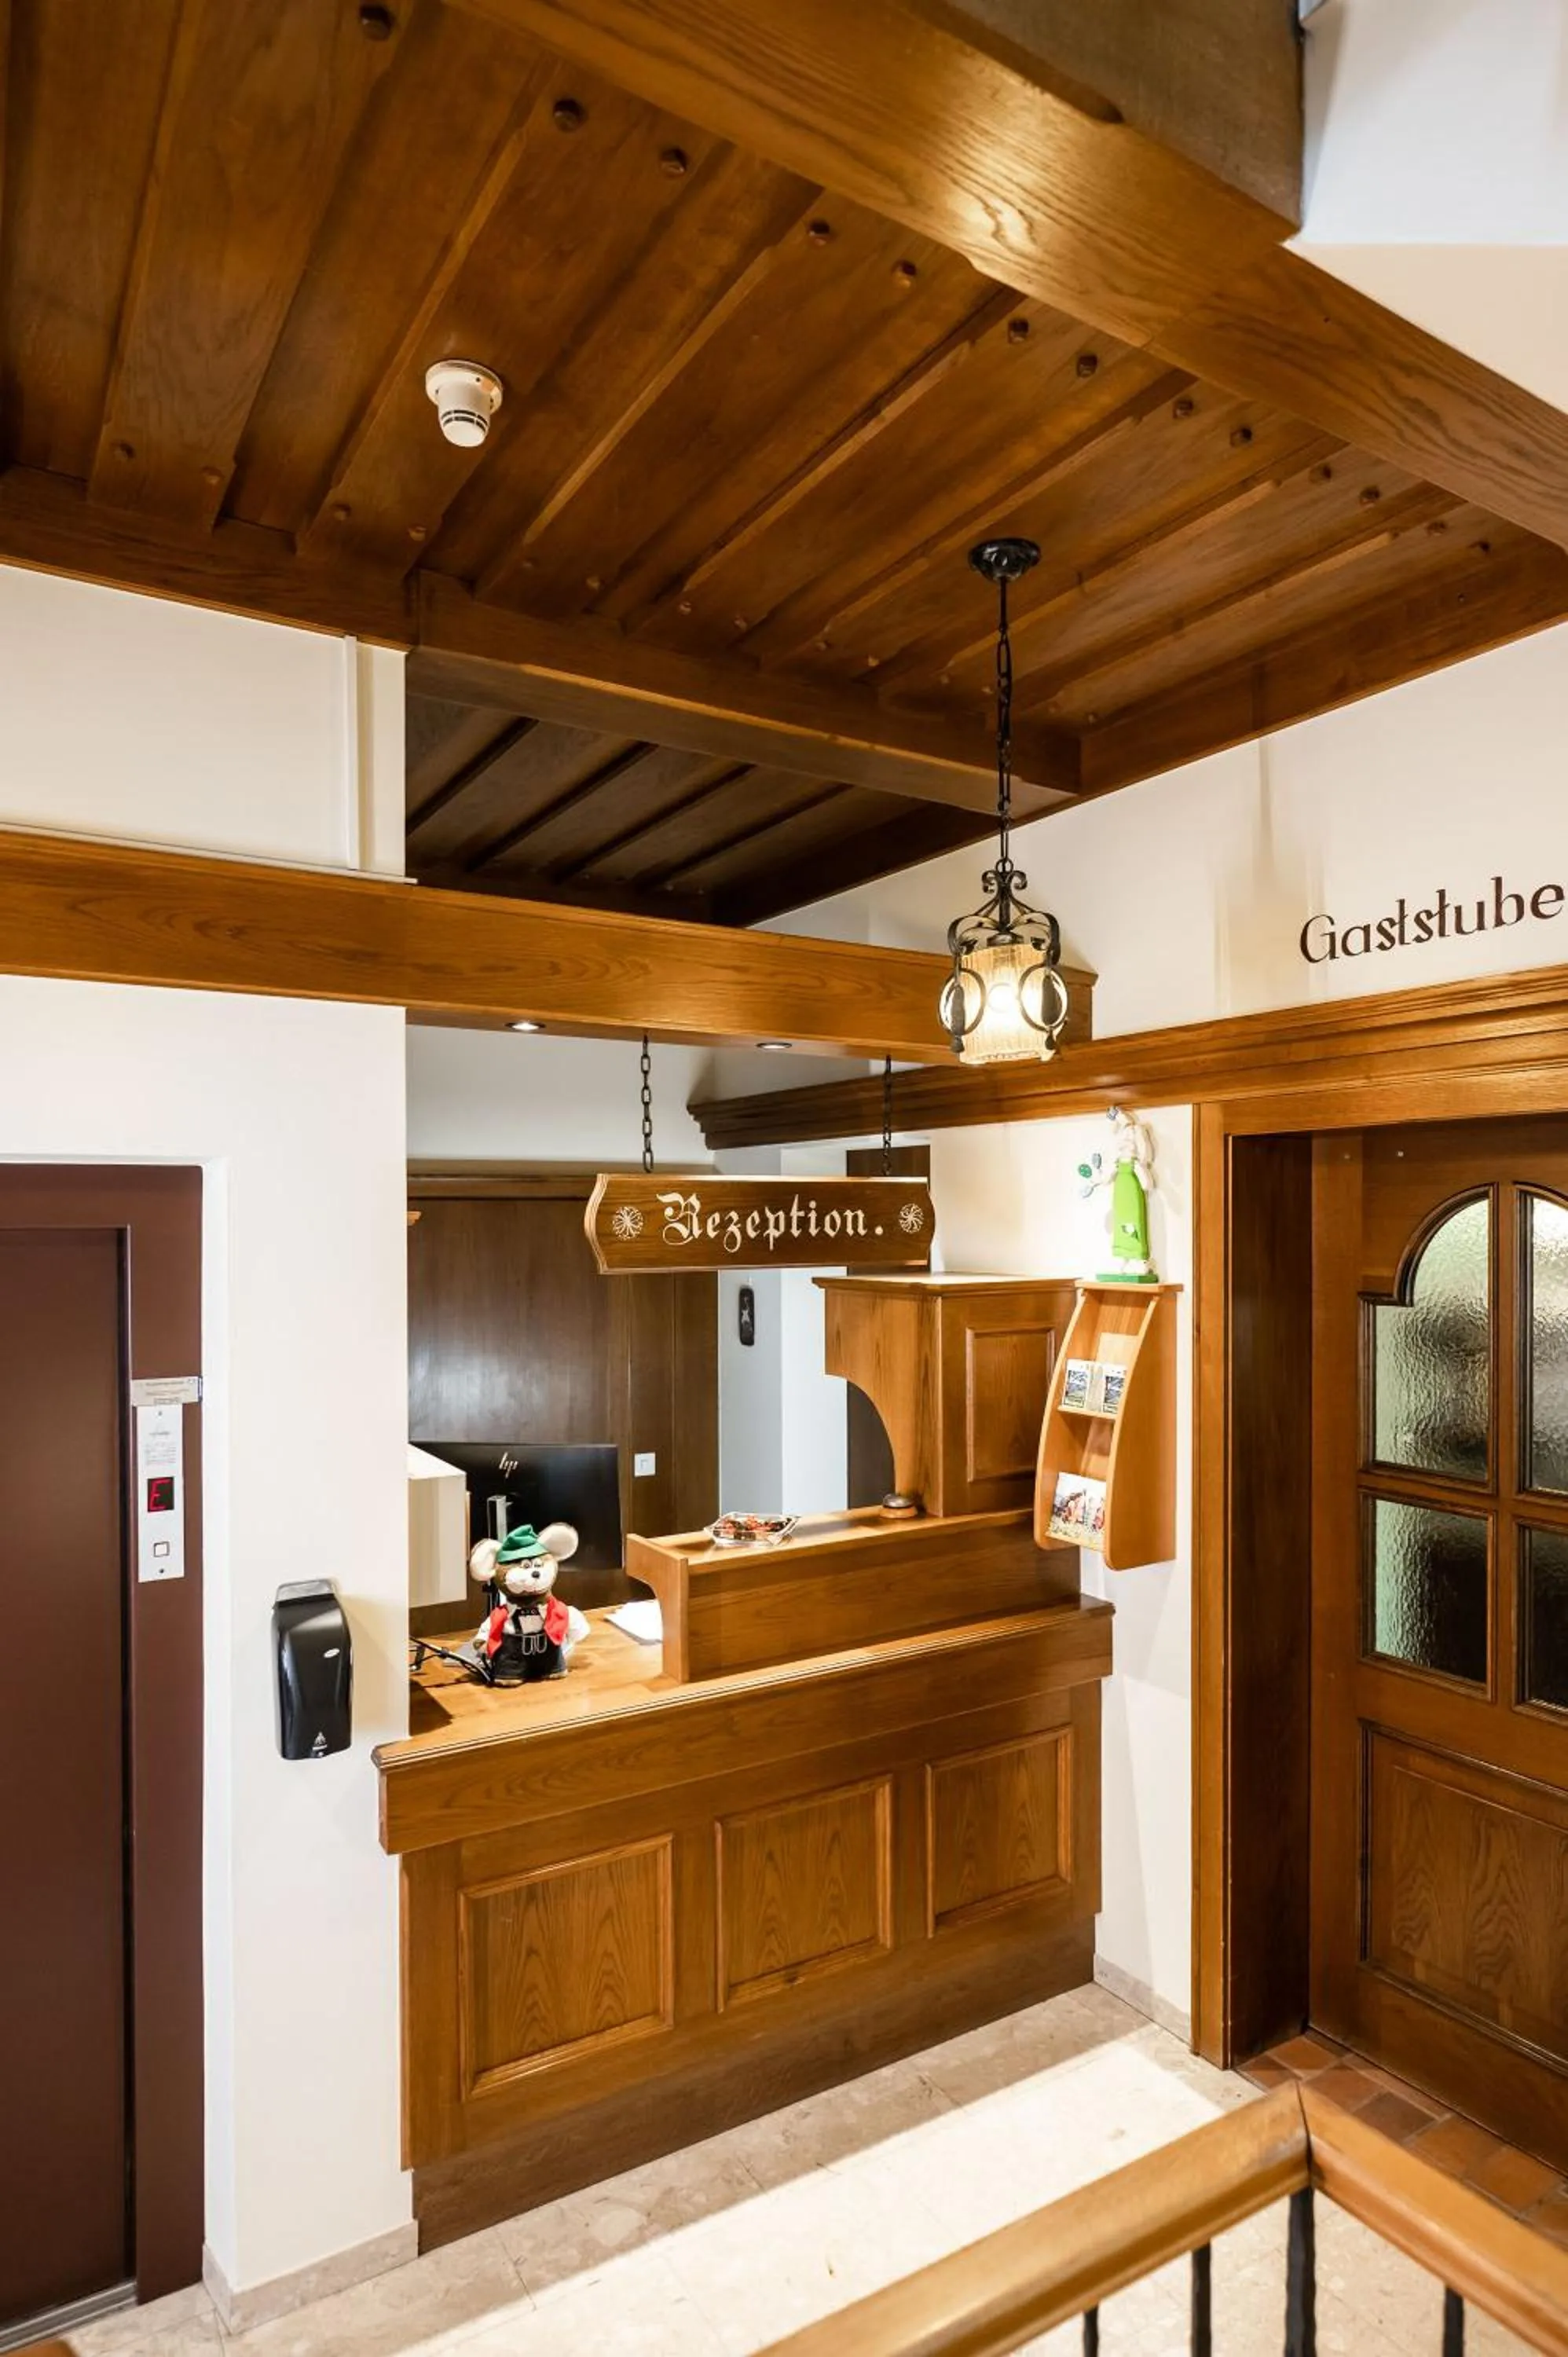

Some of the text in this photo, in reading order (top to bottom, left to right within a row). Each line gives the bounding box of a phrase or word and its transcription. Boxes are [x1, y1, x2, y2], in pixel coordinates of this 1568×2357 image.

[1299, 875, 1566, 964] Gaststube
[656, 1192, 884, 1254] Rezeption.
[498, 1452, 518, 1479] hp
[148, 1477, 170, 1511] E
